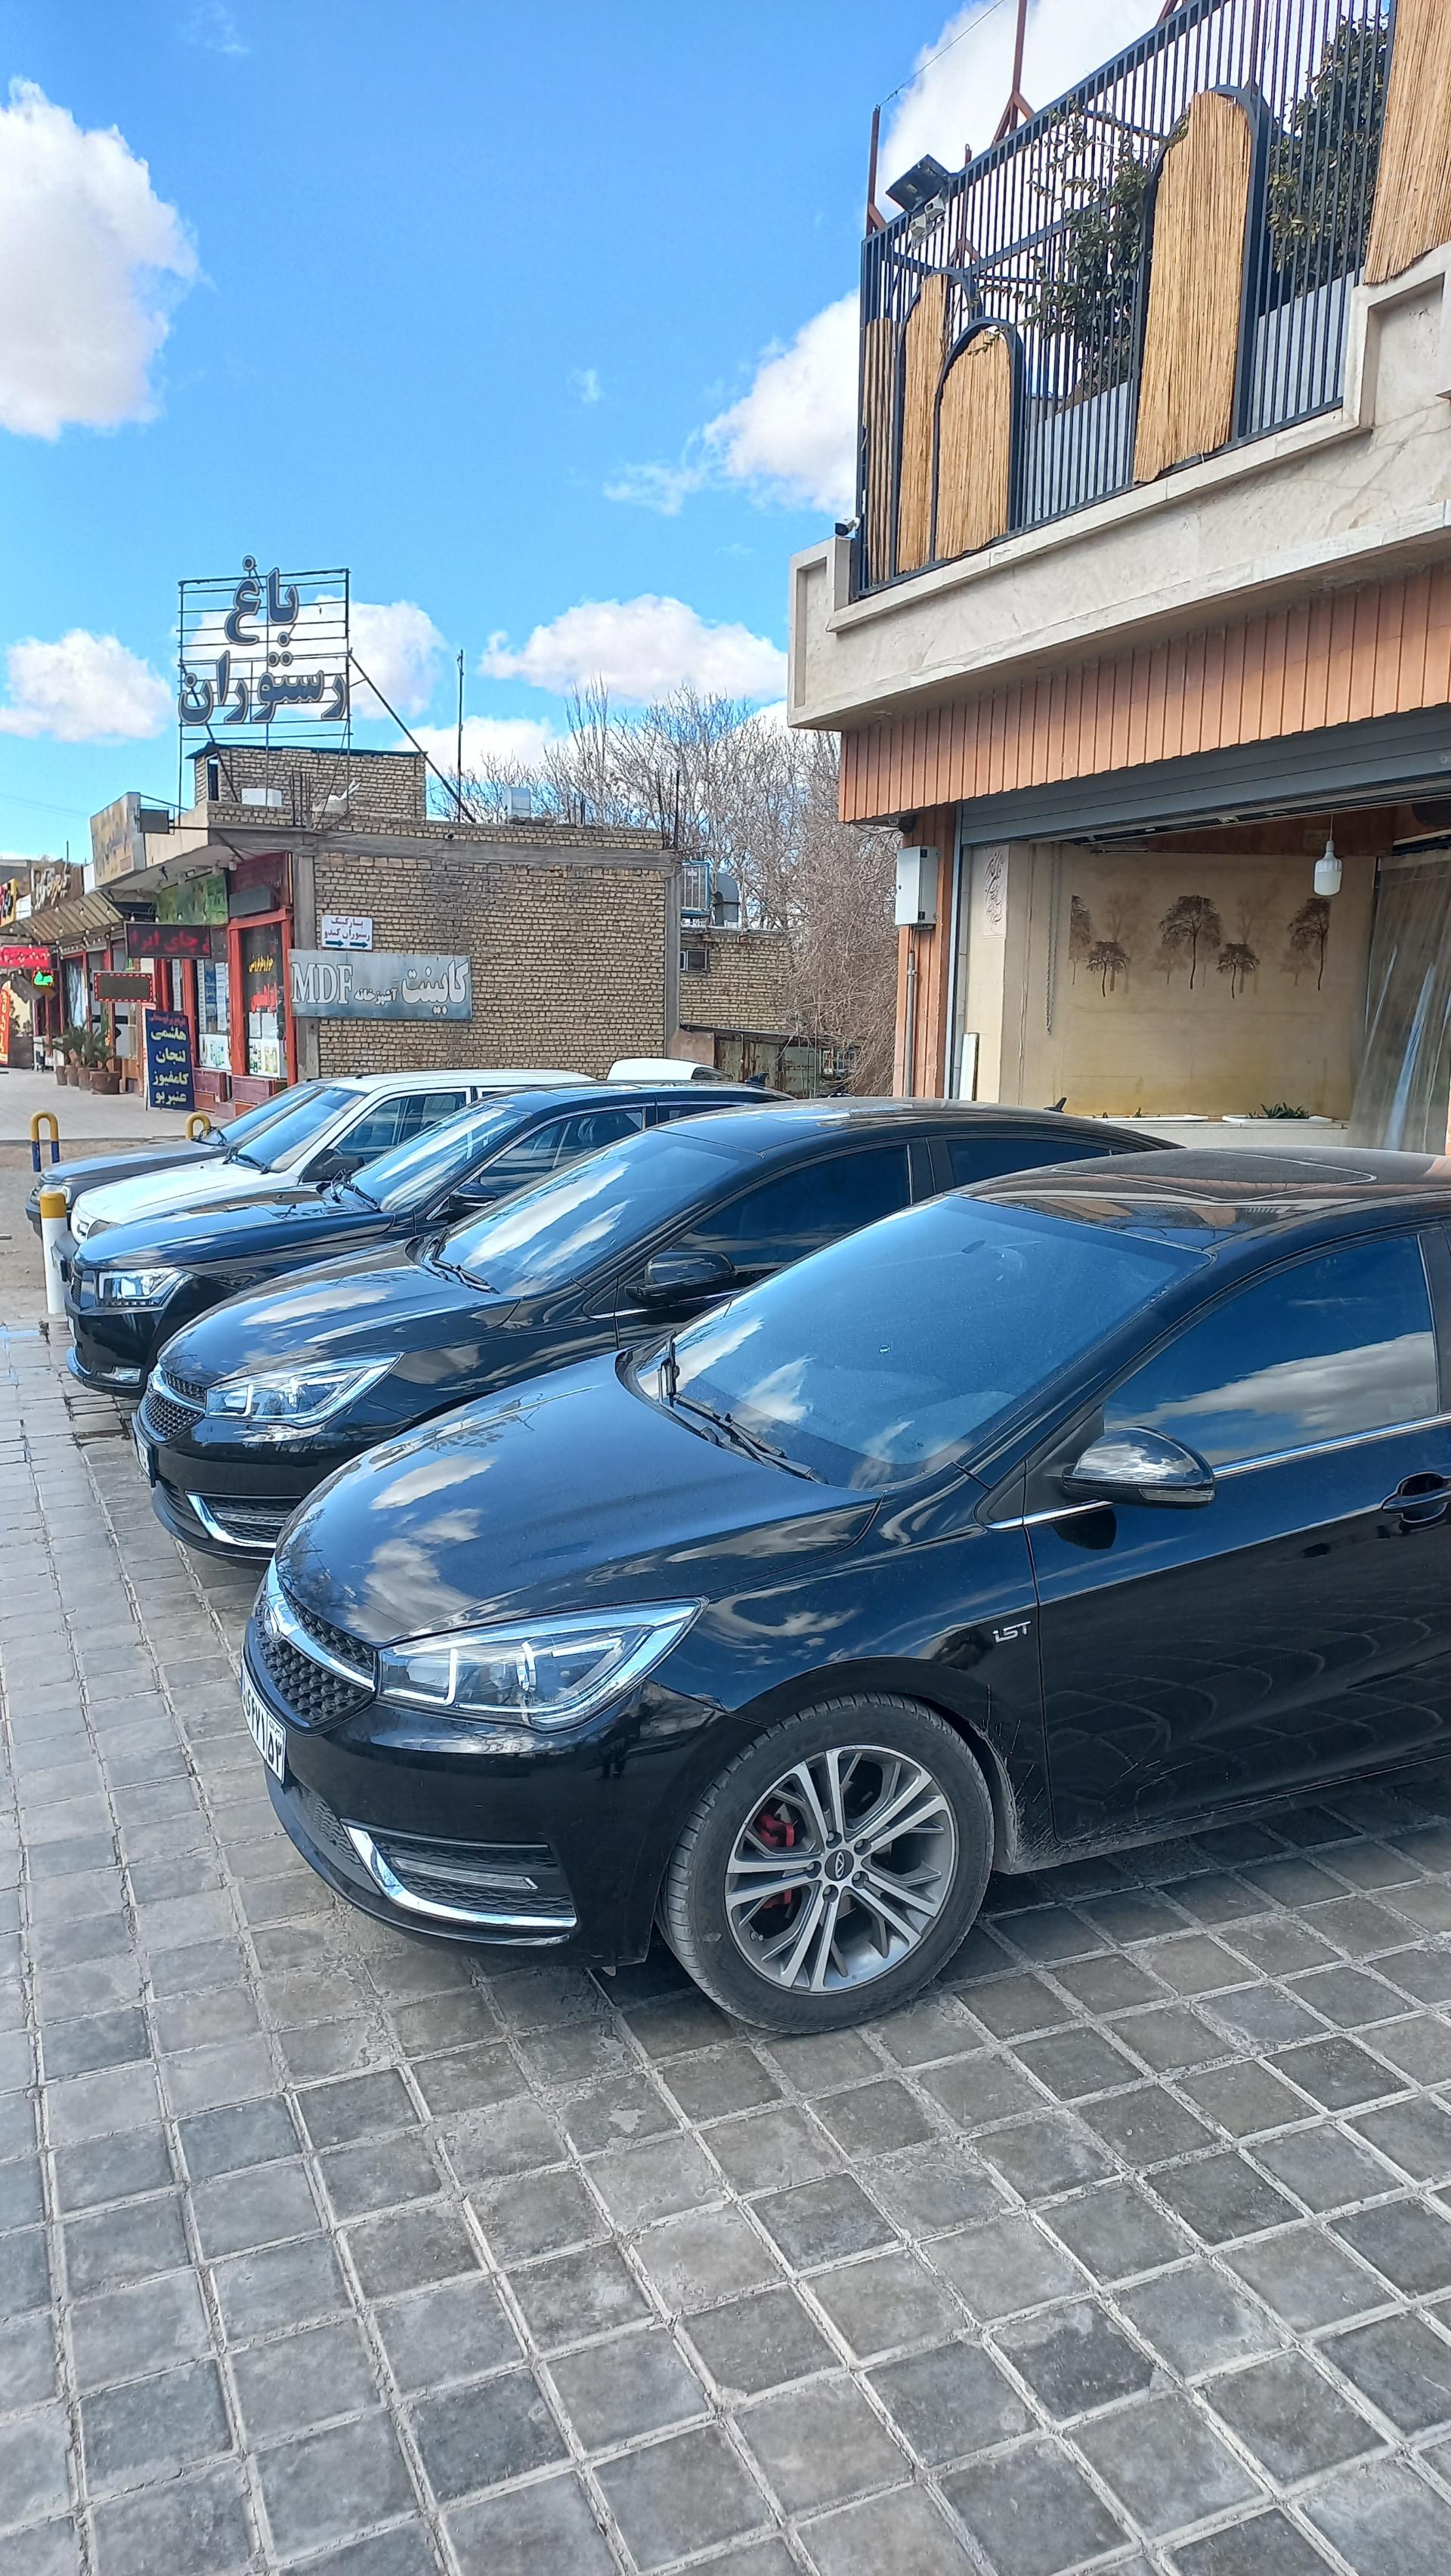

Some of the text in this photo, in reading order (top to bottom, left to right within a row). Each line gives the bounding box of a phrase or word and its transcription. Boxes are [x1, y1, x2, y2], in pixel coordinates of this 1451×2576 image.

[224, 555, 299, 647] باغ
[178, 651, 347, 725] رستوران
[324, 928, 370, 942] رستوران کندو
[291, 961, 354, 1005] MDF
[401, 960, 469, 1015] کابینت
[151, 1026, 187, 1041] هاشمی
[156, 1047, 186, 1065] لنجان
